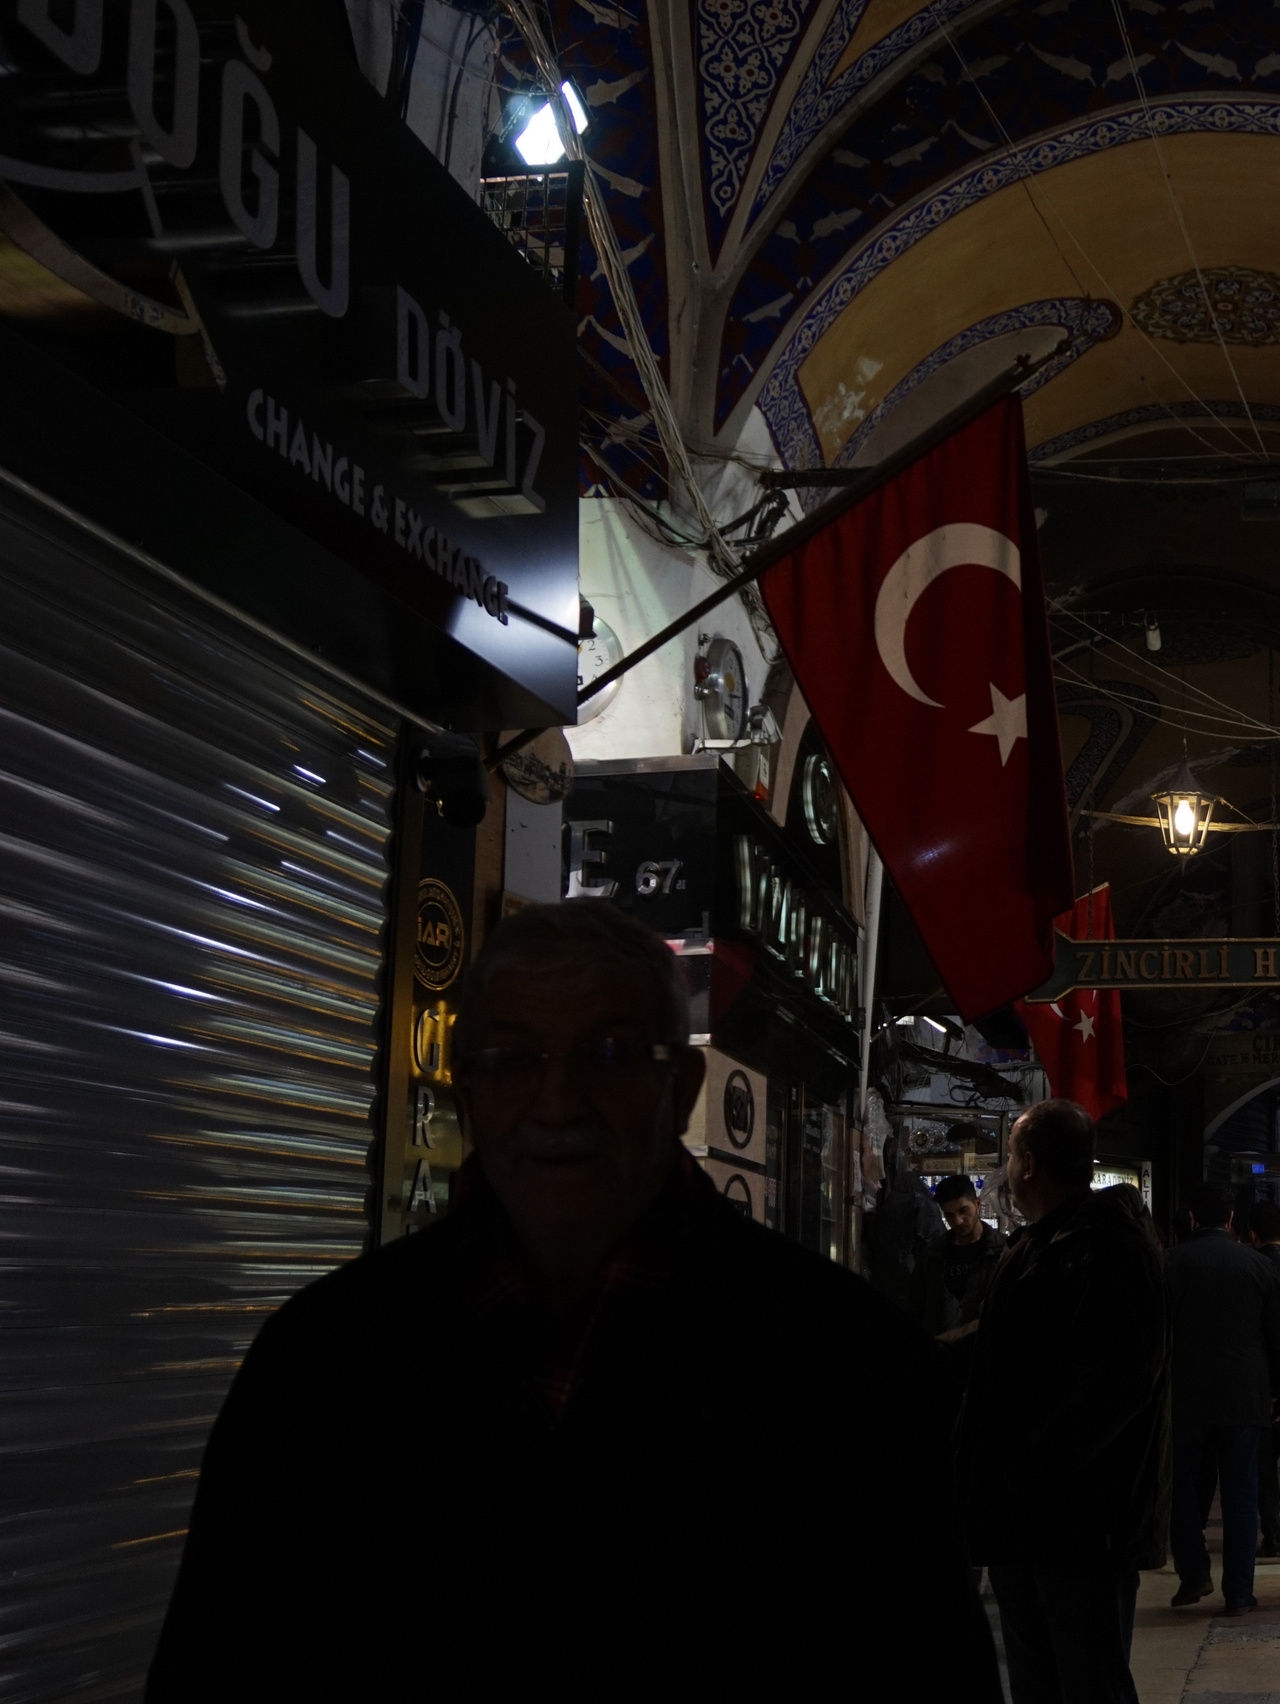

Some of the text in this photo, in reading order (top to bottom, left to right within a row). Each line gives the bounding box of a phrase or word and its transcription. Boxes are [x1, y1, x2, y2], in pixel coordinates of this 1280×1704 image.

[247, 388, 508, 626] CHANGE & EXCHANGE
[397, 284, 546, 513] DÖVİZ
[635, 859, 683, 895] 67
[1076, 944, 1231, 982] ZİNCİRLİ
[406, 1007, 440, 1240] GRA
